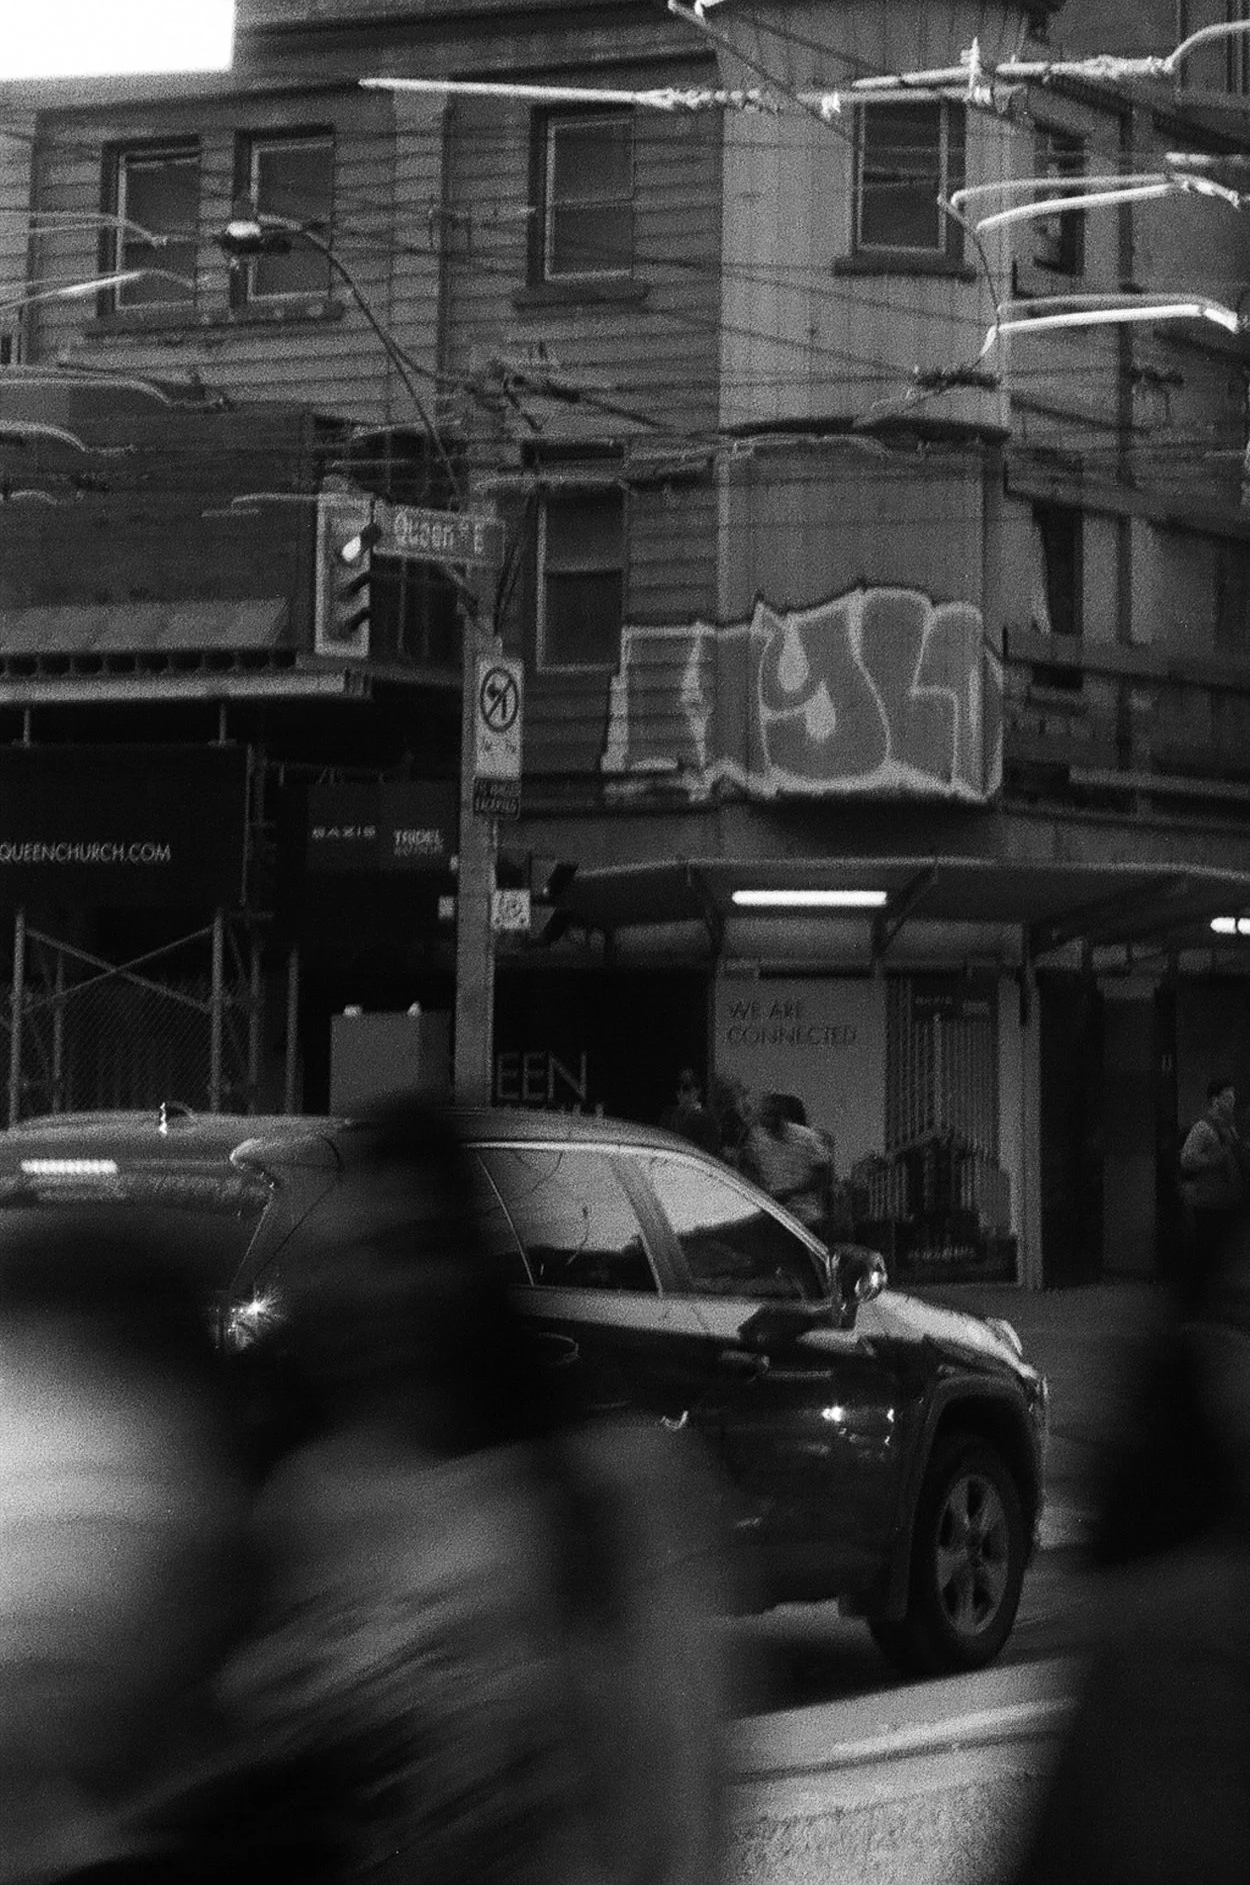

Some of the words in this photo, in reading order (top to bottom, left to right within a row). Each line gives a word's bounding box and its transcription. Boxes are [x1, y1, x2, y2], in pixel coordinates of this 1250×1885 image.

[394, 510, 455, 551] Queen
[473, 522, 485, 554] E
[0, 841, 171, 864] QUEENCHURCH.COM
[729, 999, 761, 1019] WE
[768, 998, 802, 1018] ARE
[727, 1025, 857, 1045] CONNECTED
